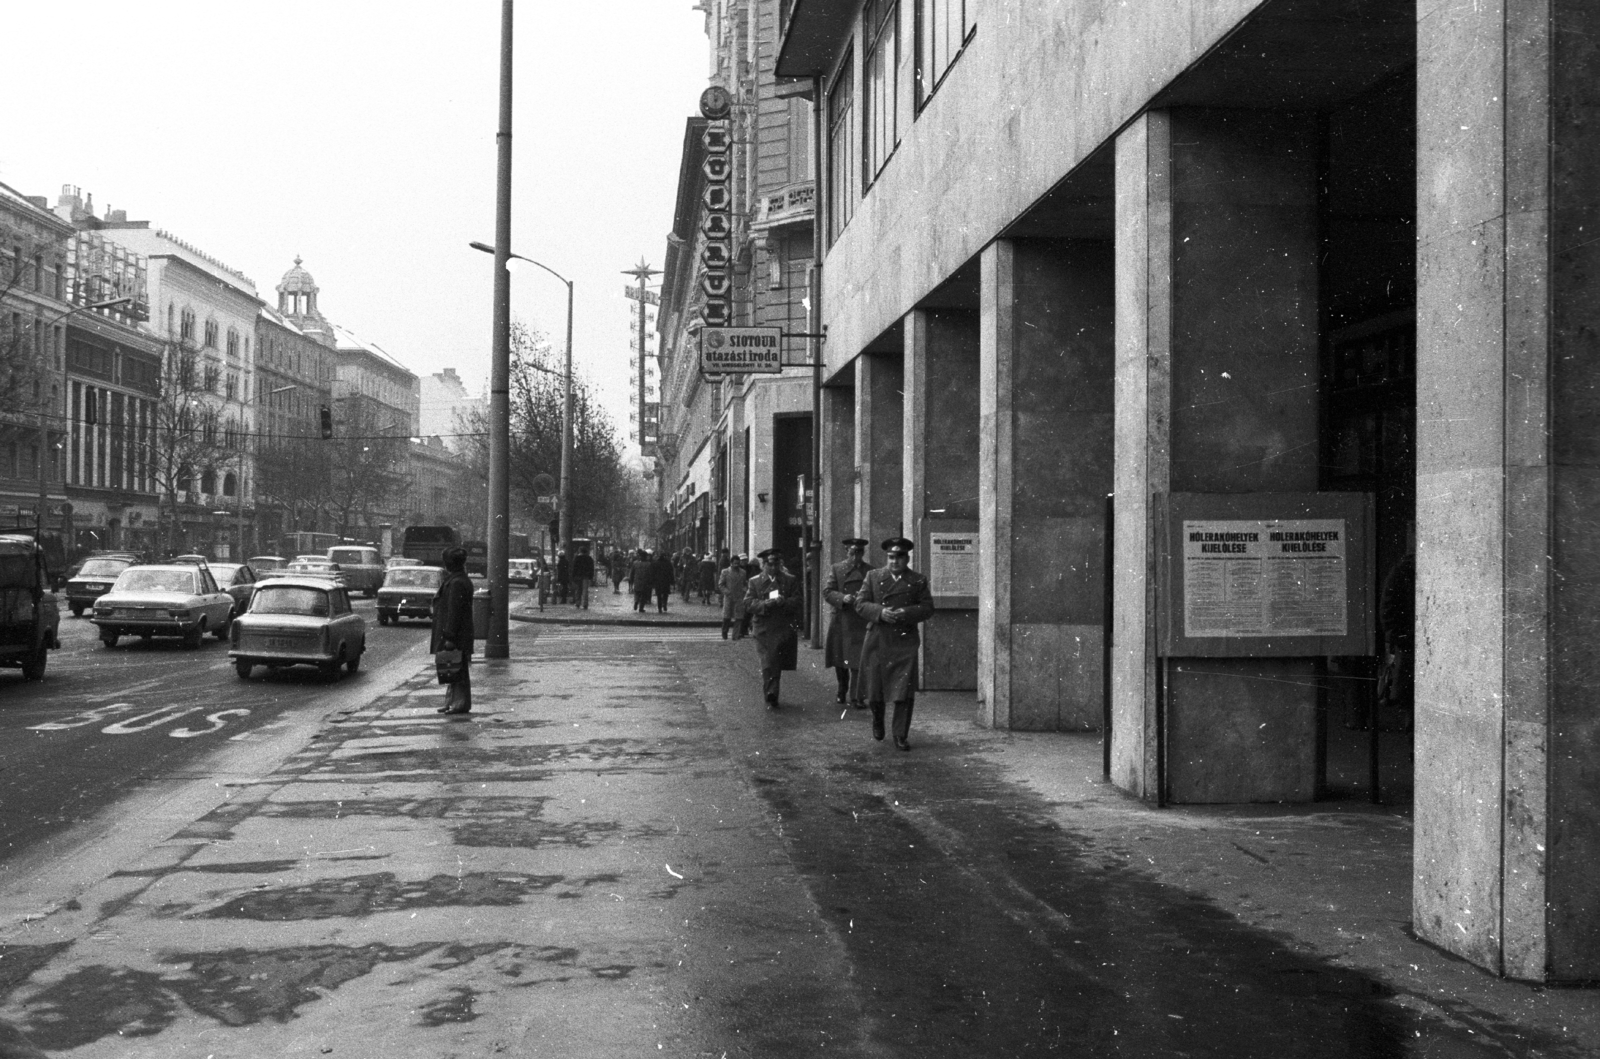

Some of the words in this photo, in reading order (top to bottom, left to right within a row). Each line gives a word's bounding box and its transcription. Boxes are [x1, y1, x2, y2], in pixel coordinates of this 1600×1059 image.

[729, 334, 777, 348] SIOTOUR
[705, 349, 747, 362] utazási
[749, 348, 779, 362] iroda
[25, 702, 250, 738] BUS
